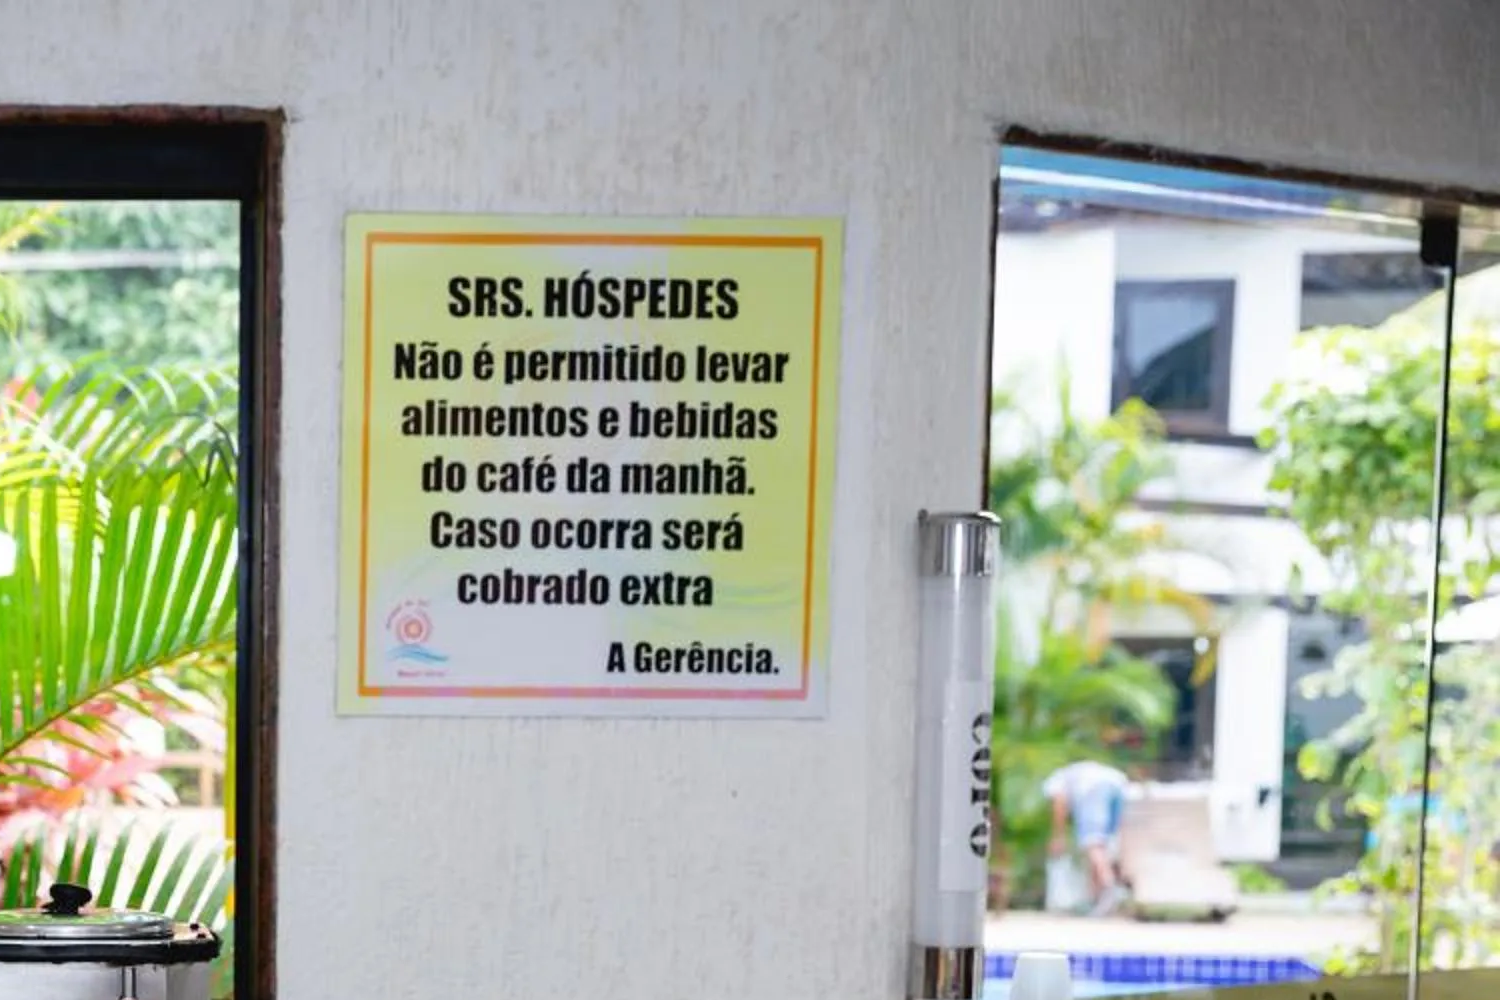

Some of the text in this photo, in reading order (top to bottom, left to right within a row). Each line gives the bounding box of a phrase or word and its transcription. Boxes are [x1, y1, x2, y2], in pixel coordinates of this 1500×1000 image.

[448, 270, 740, 320] SRS. HÓSPEDES
[394, 341, 790, 385] Não é permitido levar
[401, 399, 778, 440] alimentos e bebidas
[422, 455, 756, 495] do café da manhã.
[430, 511, 744, 551] Caso ocorra será
[457, 568, 714, 607] cobrado extra
[606, 641, 780, 675] A Gerência.
